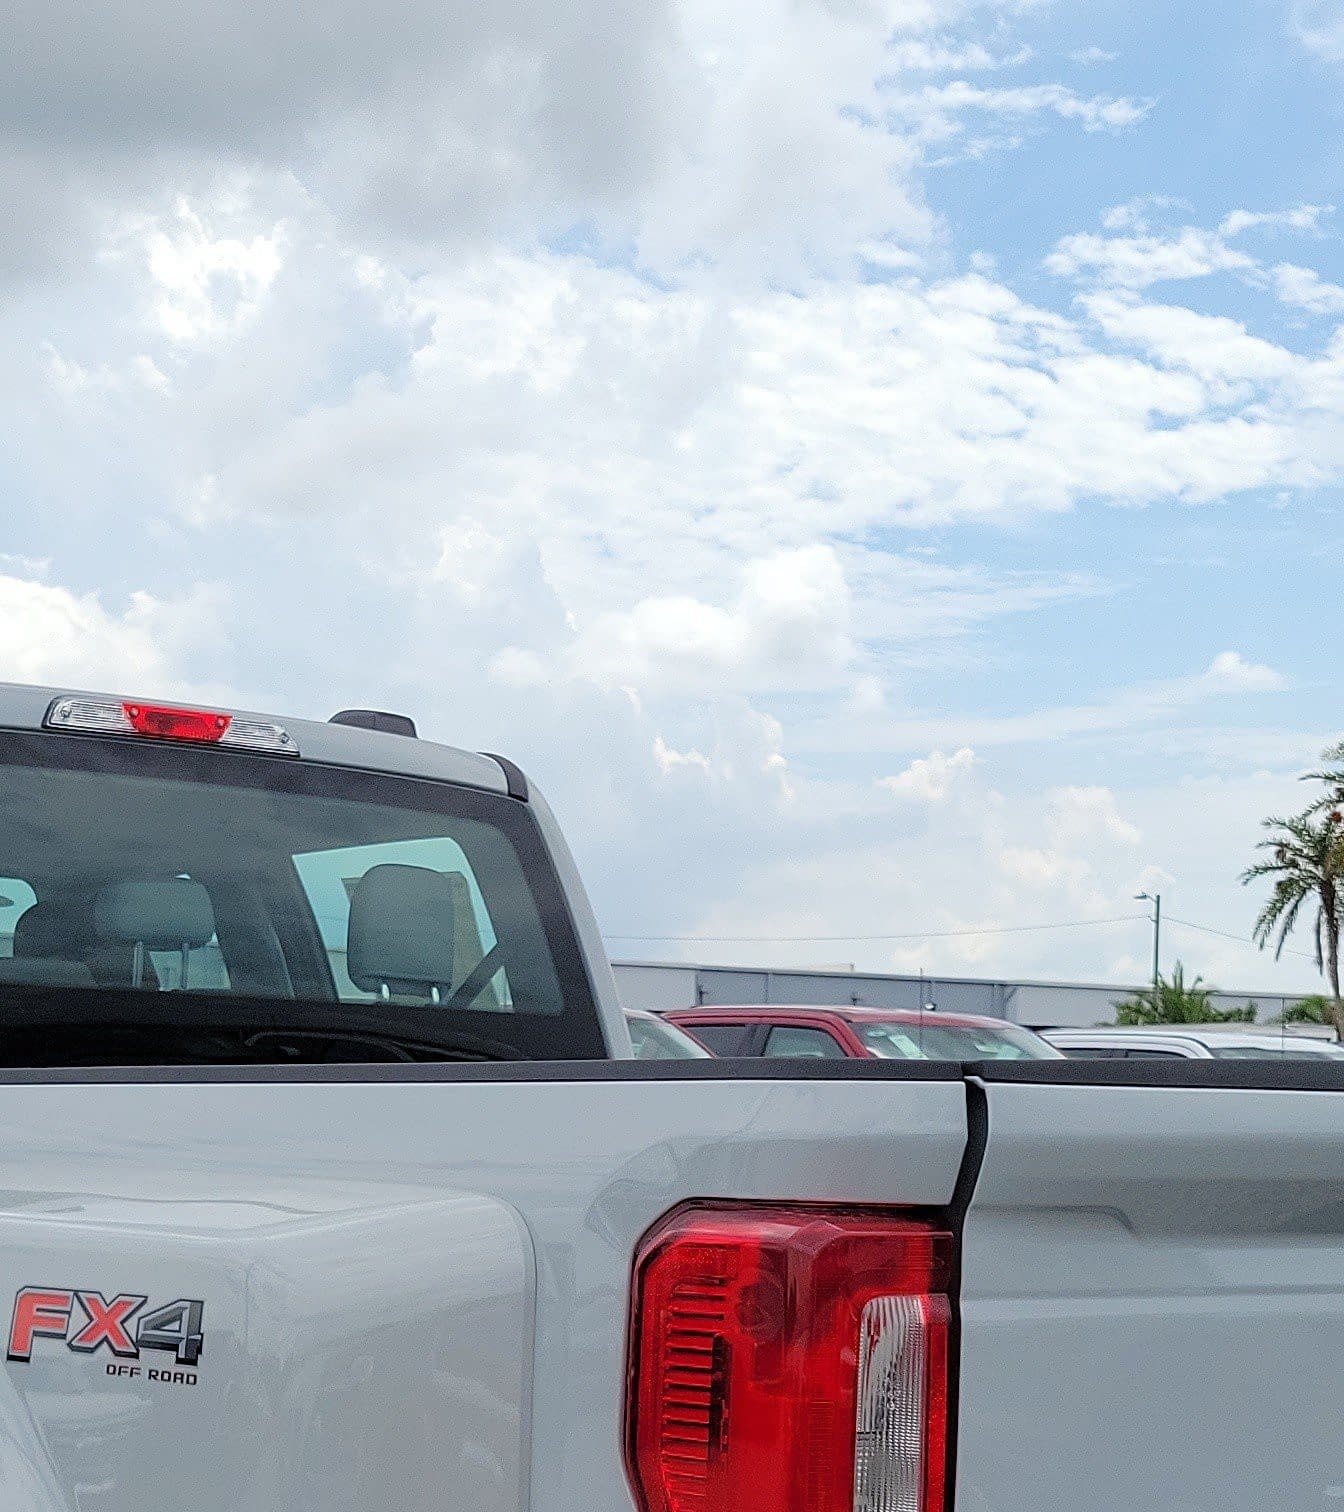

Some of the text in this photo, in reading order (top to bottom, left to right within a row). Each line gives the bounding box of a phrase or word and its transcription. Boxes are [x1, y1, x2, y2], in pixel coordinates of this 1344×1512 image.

[7, 1286, 204, 1366] FX4
[106, 1364, 197, 1386] OFF ROAD
